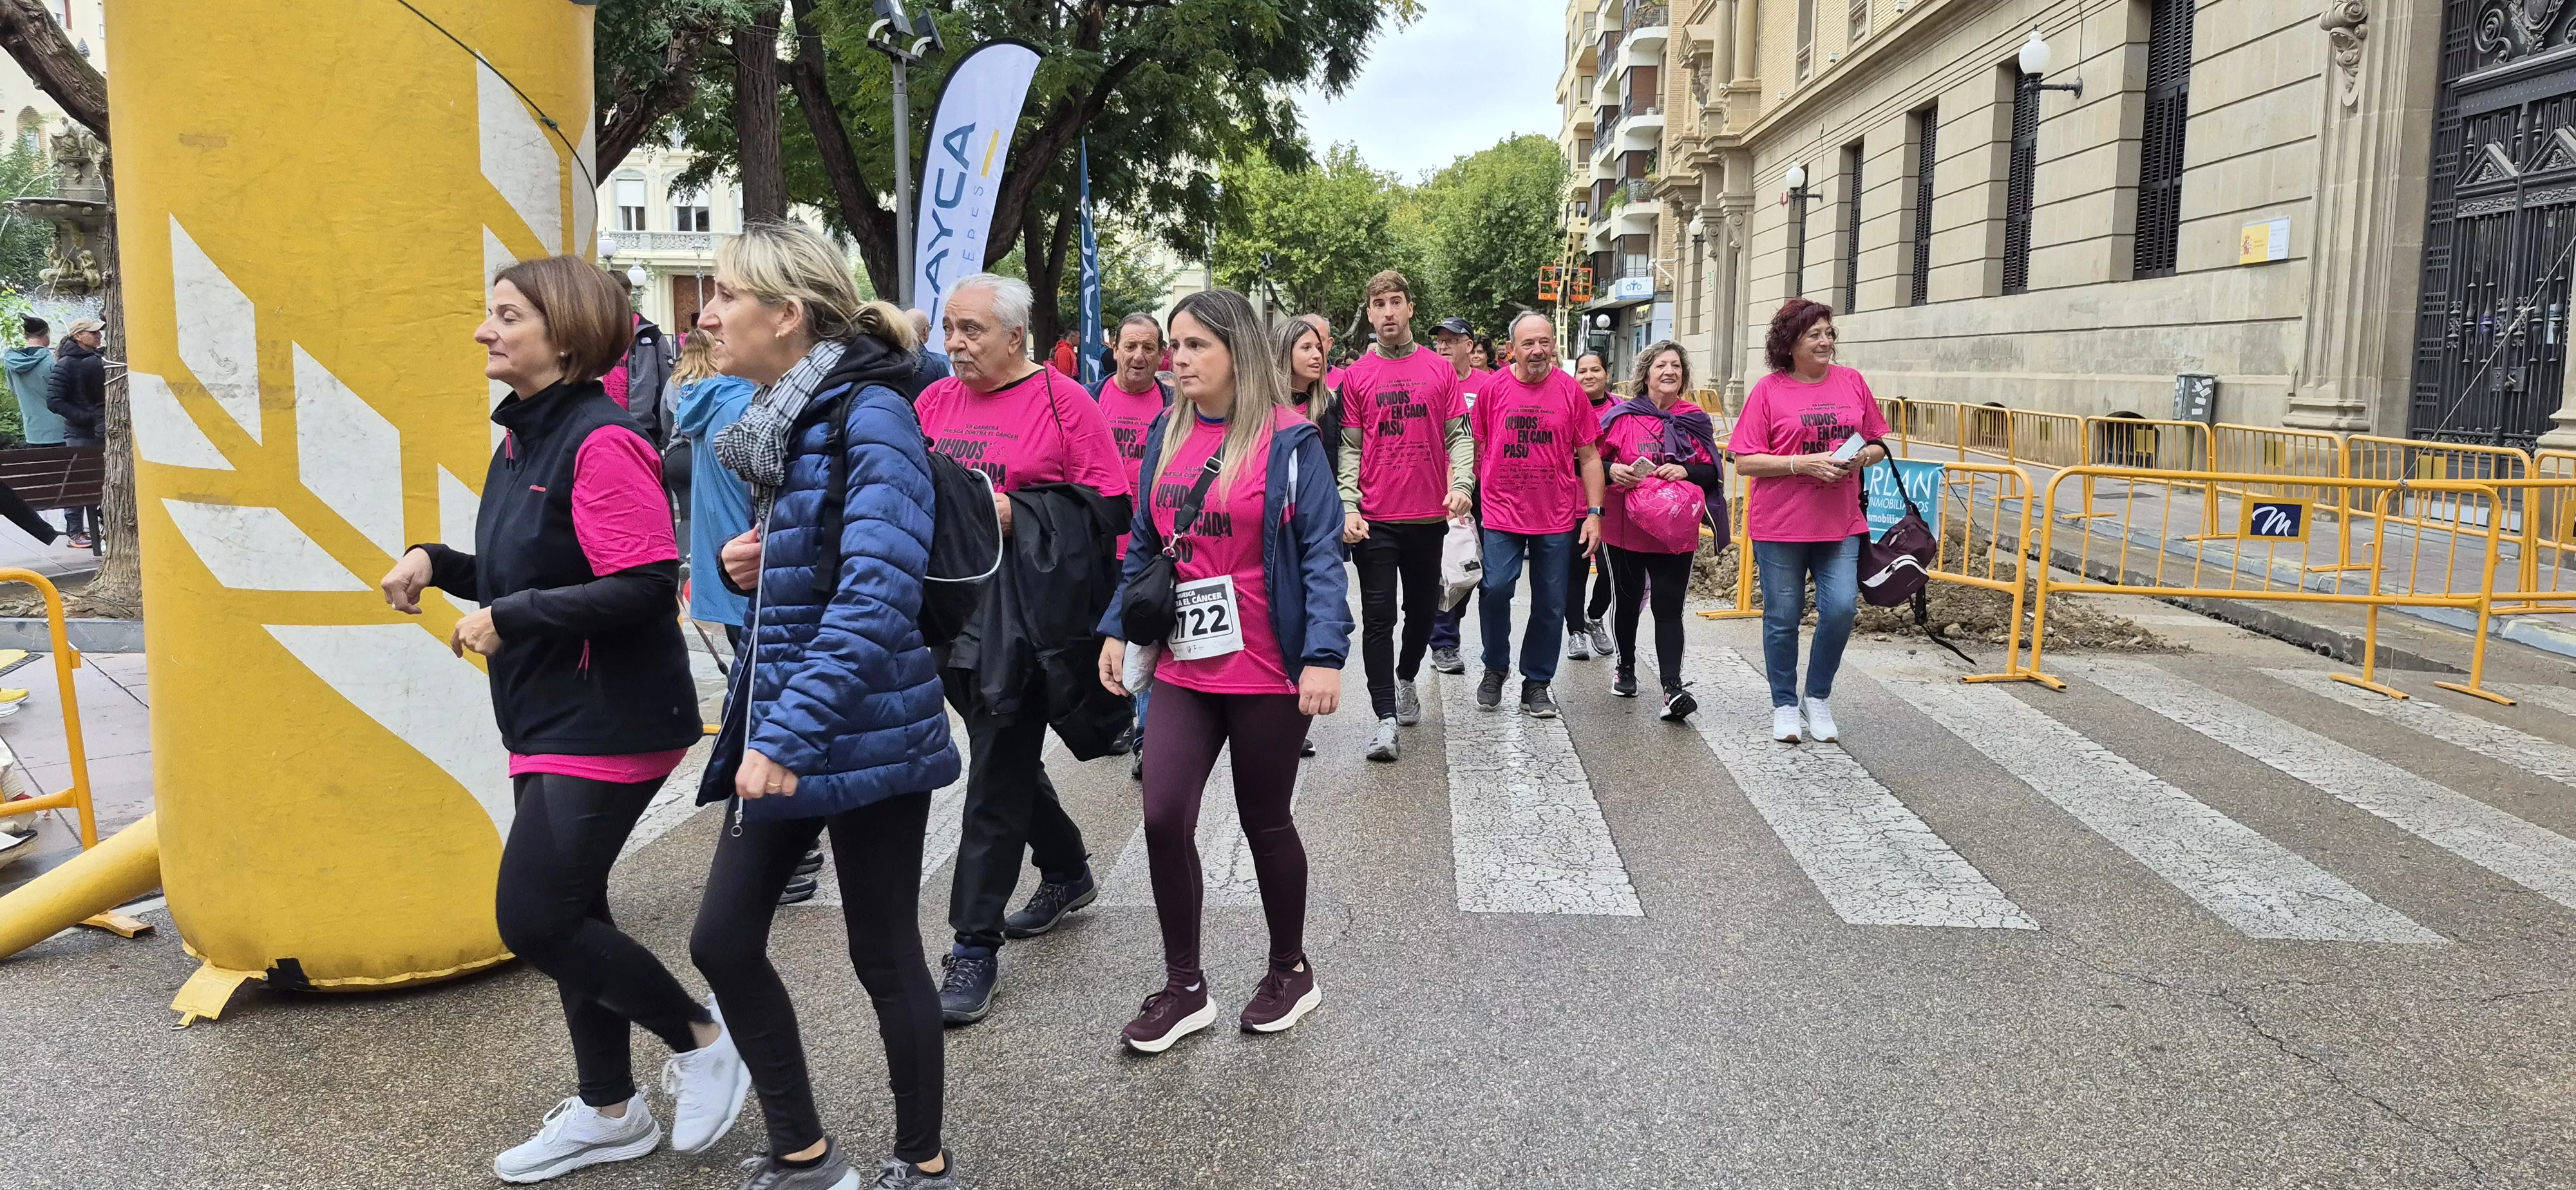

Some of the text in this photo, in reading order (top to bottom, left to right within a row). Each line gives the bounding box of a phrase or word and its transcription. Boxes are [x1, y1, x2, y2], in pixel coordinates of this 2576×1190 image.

[1376, 390, 1410, 407] UNIDOS
[1392, 403, 1427, 419] EN CADA
[1505, 416, 1538, 430] UNIDOS
[1801, 412, 1837, 426] UNIDOS
[1378, 420, 1404, 437] PASO
[1817, 426, 1829, 440] EN
[1518, 430, 1553, 444] EN CADA
[1503, 444, 1529, 458] PASO
[1803, 441, 1830, 455] PASO
[1864, 466, 1933, 499] RLAN
[1192, 592, 1222, 603] CÁNCER
